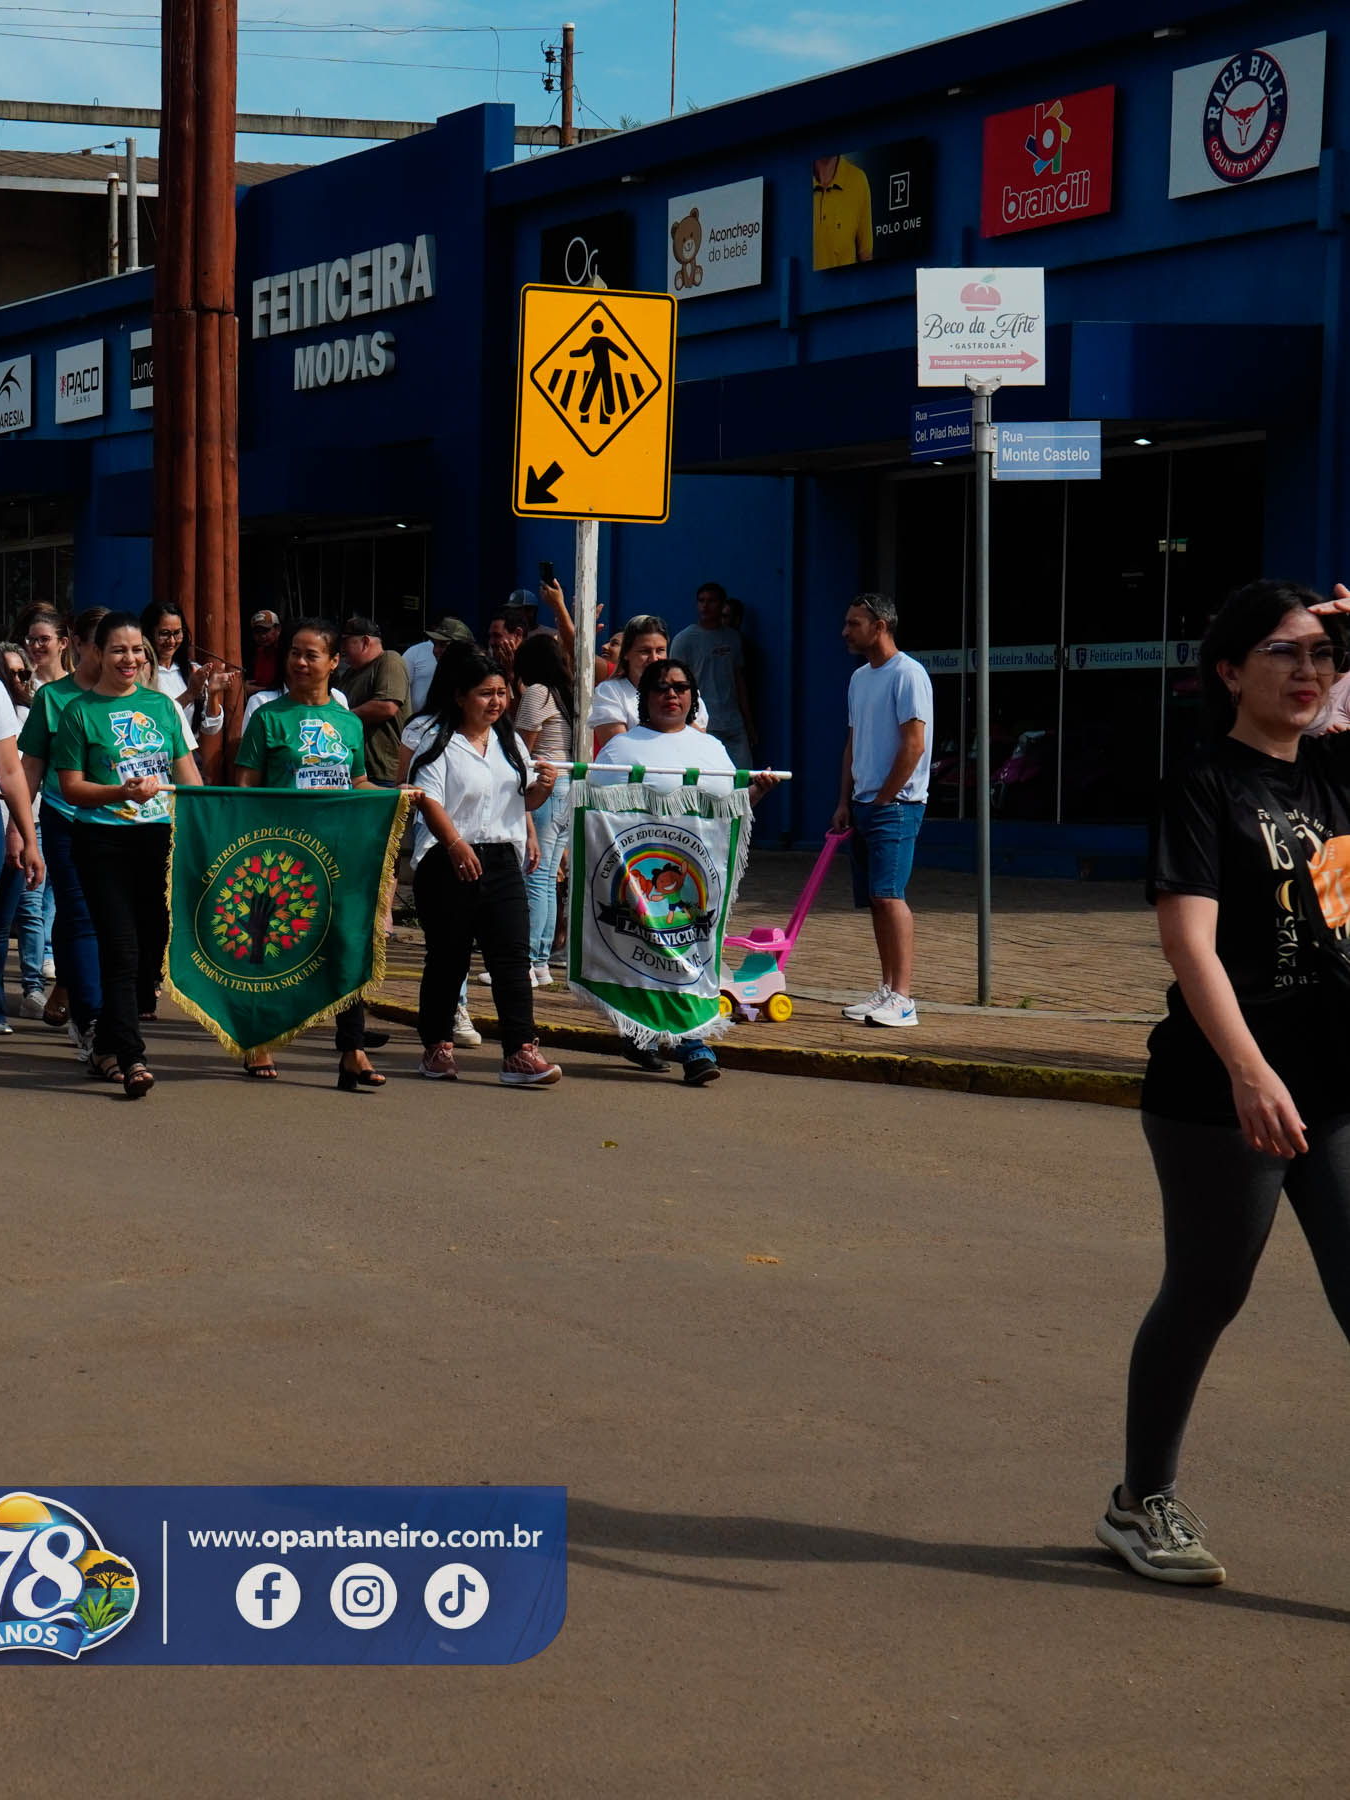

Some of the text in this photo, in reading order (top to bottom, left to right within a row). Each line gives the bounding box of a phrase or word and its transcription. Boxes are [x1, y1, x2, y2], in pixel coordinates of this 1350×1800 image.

[1208, 55, 1284, 121] RACE BULL
[1211, 126, 1279, 174] COUNTRY WEAR
[1002, 169, 1091, 224] brandili
[708, 220, 761, 244] Aconchego
[876, 216, 922, 237] POLO ONE
[708, 239, 748, 263] do bebê
[252, 234, 436, 340] FEITICEIRA
[923, 312, 1040, 339] Beco da Arte
[954, 342, 1007, 350] GASTROBAR
[132, 357, 154, 381] Lune
[293, 330, 396, 391] MODAS
[66, 366, 100, 397] PACO
[72, 395, 91, 406] JEANS
[915, 410, 928, 421] Rua
[915, 423, 970, 442] Cel. Pilad Rebuá
[1002, 431, 1024, 442] Rua
[1002, 446, 1091, 463] Monte Castelo
[988, 651, 1054, 665] eiticeira Modas
[1089, 648, 1133, 663] Feiticeira
[620, 835, 635, 848] DE
[636, 829, 691, 845] EDUCAÇÃO
[201, 827, 342, 884] CENTRO DE EDUCAÇÃO INFANTIL
[229, 978, 281, 993] TEIXEIRA
[280, 955, 326, 989] SIQUEIRA
